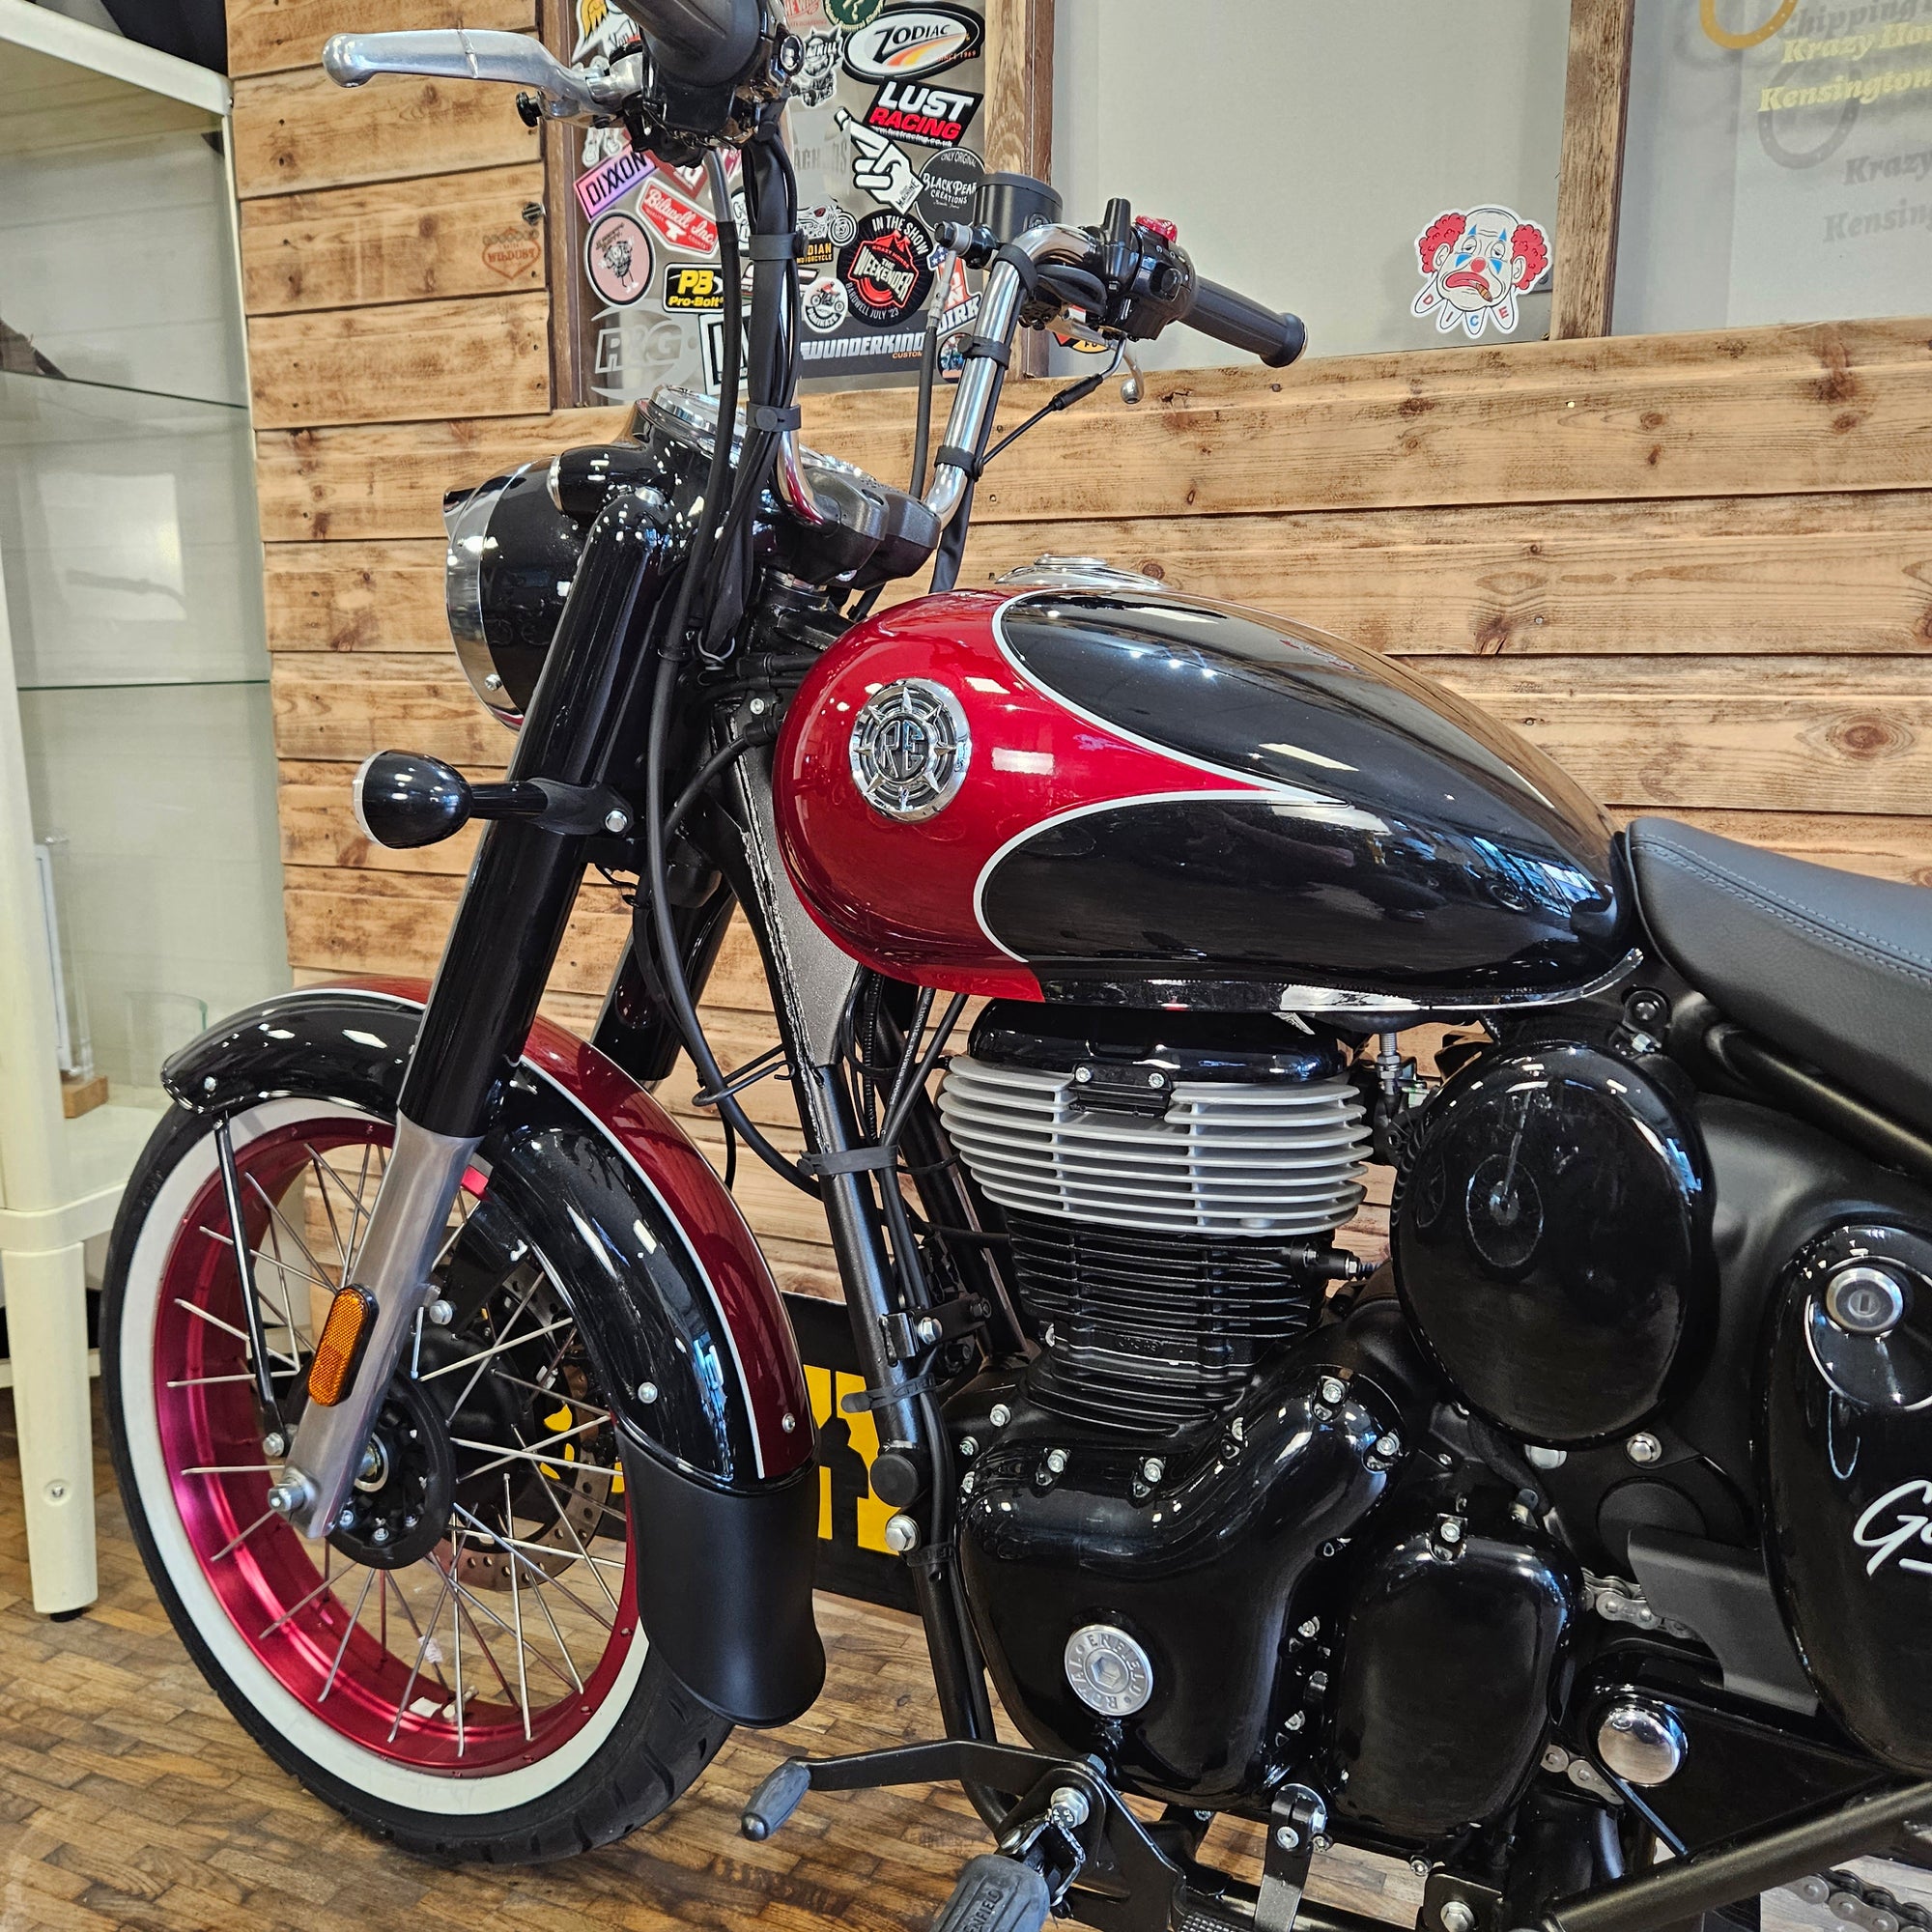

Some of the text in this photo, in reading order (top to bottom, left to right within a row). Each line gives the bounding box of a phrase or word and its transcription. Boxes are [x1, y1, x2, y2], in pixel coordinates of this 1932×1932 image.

[873, 24, 951, 65] ZODIAC
[1781, 34, 1875, 64] Krazy
[878, 80, 975, 122] LUST
[869, 106, 962, 140] RACING
[585, 151, 648, 207] DIXXON
[922, 172, 953, 194] BLACK
[930, 189, 968, 205] CREATIONS
[807, 242, 832, 256] DIAN
[871, 216, 884, 232] IN
[886, 214, 906, 231] THE
[903, 222, 929, 255] SHOW
[852, 245, 916, 301] WEEKENDER
[881, 257, 895, 270] THE
[677, 270, 715, 296] PB
[869, 309, 887, 320] JULY
[878, 718, 927, 779] RE
[1087, 1634, 1145, 1696] ENFIELD
